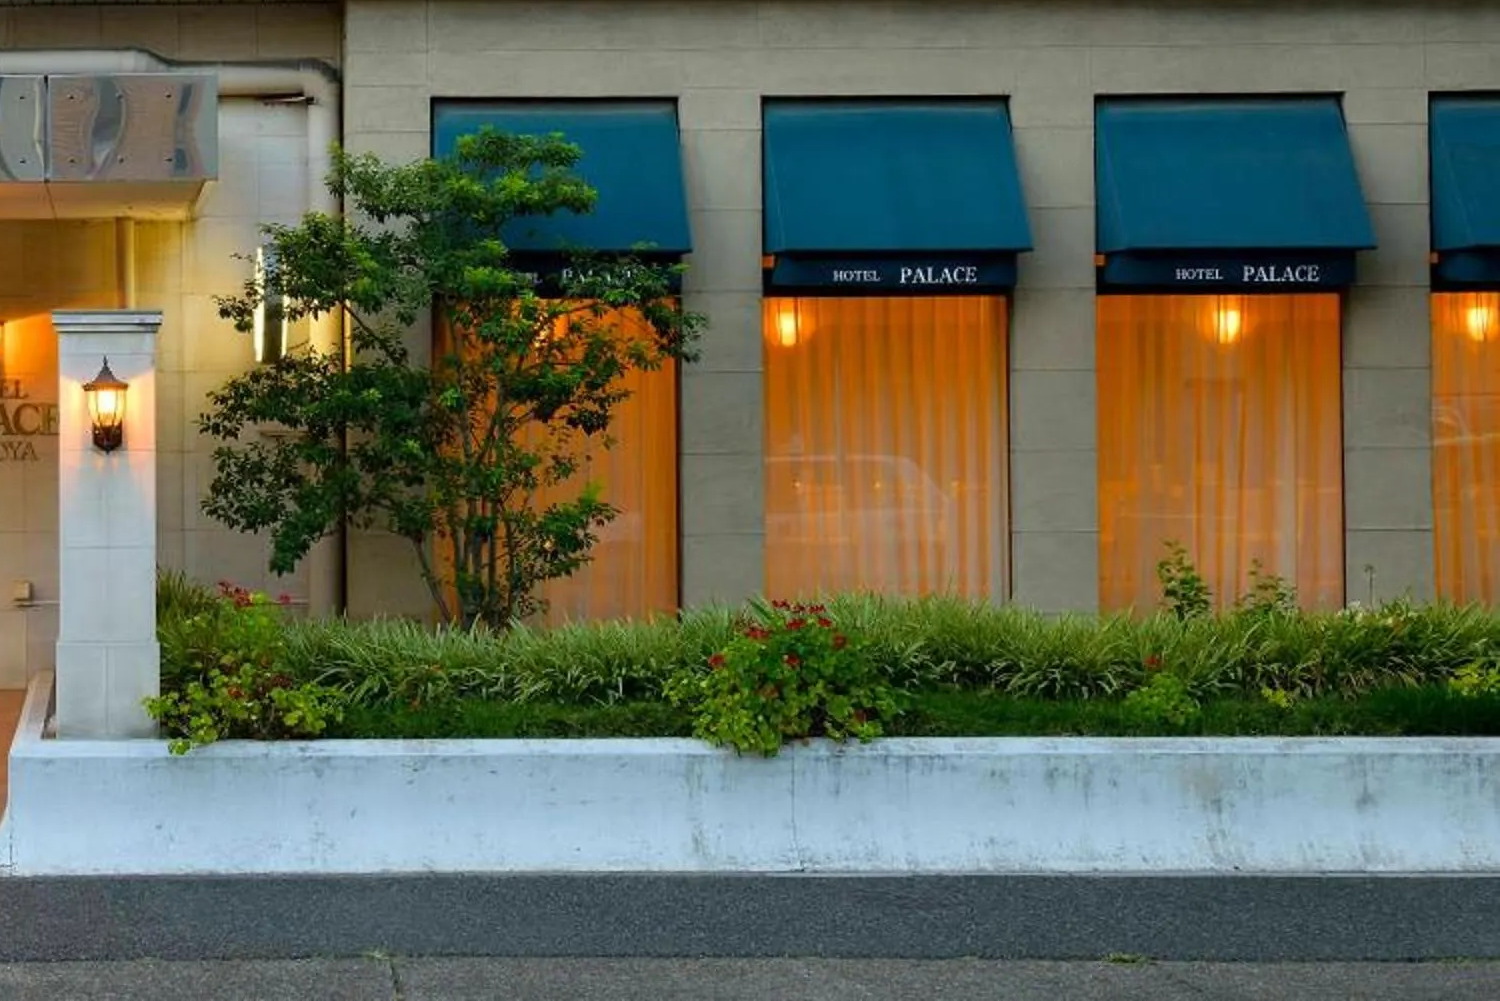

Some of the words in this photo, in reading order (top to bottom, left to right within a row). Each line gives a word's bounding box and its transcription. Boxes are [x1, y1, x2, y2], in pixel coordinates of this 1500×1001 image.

[833, 270, 881, 282] HOTEL
[899, 266, 978, 284] PALACE
[1175, 268, 1224, 280] HOTEL
[1242, 265, 1320, 282] PALACE
